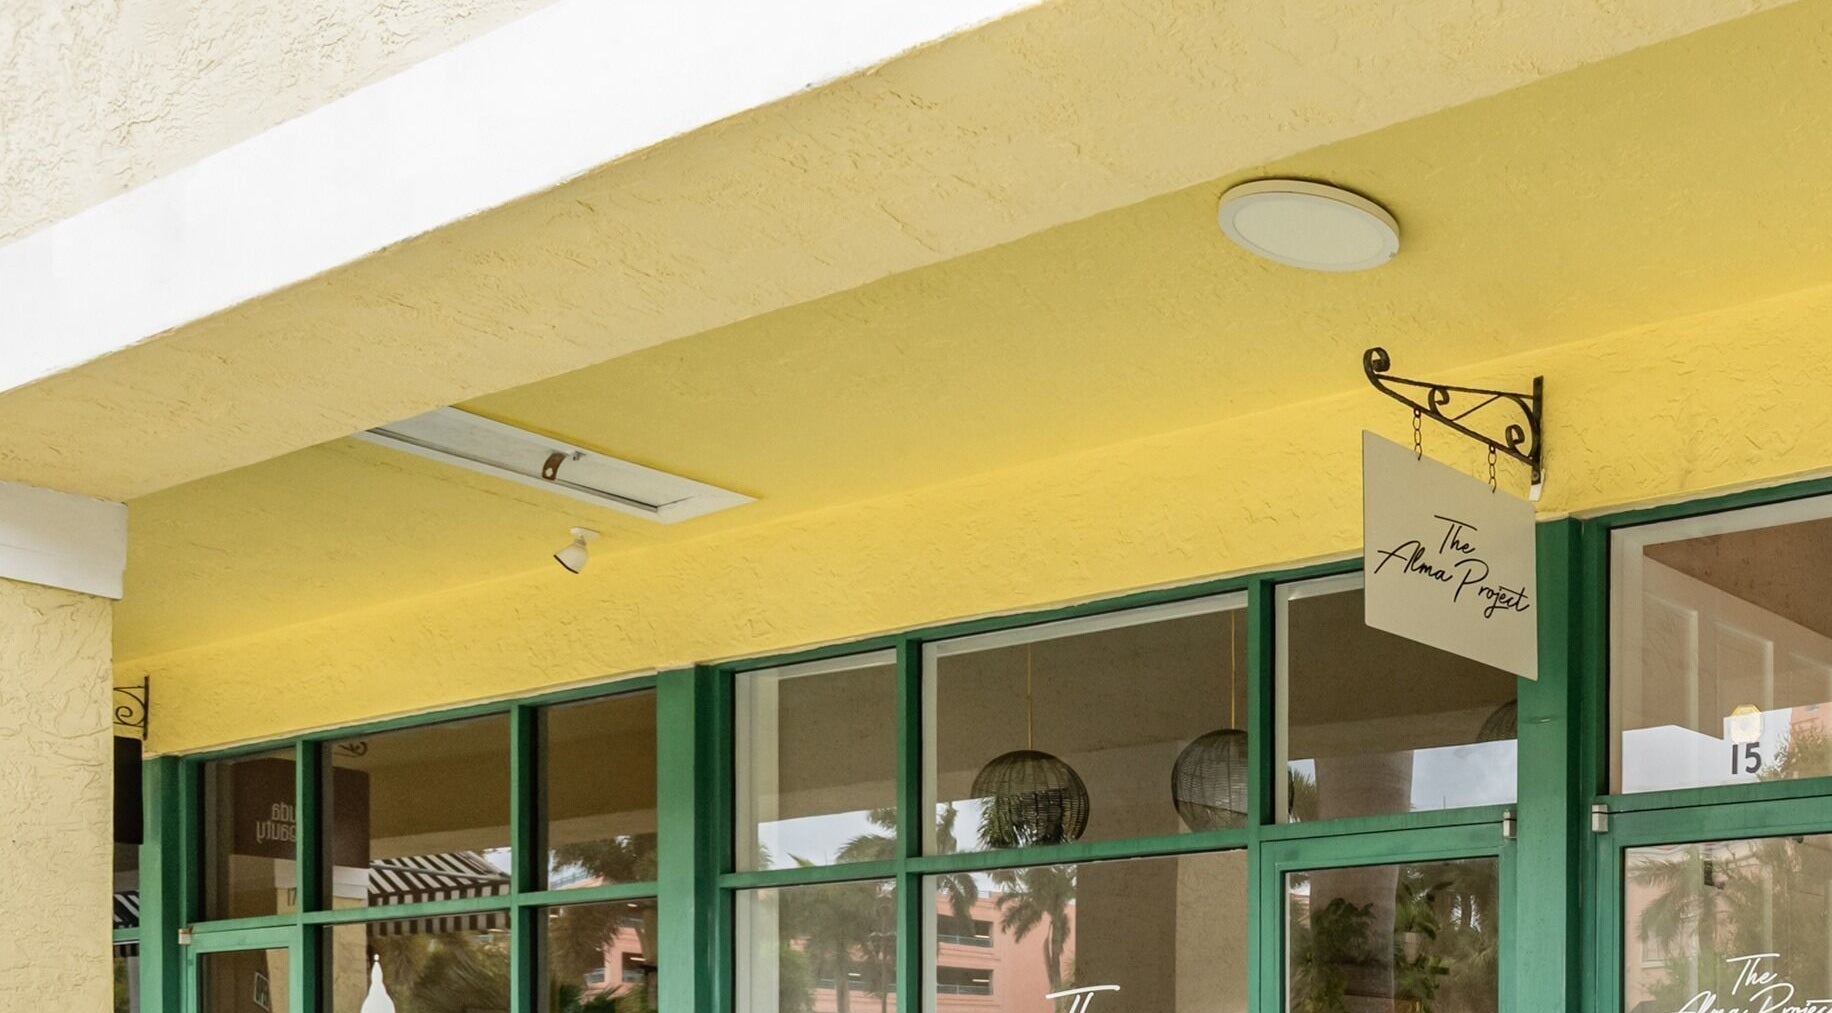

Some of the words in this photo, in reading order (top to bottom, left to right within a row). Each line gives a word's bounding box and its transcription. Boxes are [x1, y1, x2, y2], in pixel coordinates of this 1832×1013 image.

[1434, 514, 1478, 555] The
[1374, 540, 1453, 582] Alma
[1454, 558, 1530, 619] Project
[1731, 741, 1762, 775] 15
[1727, 953, 1780, 995] The
